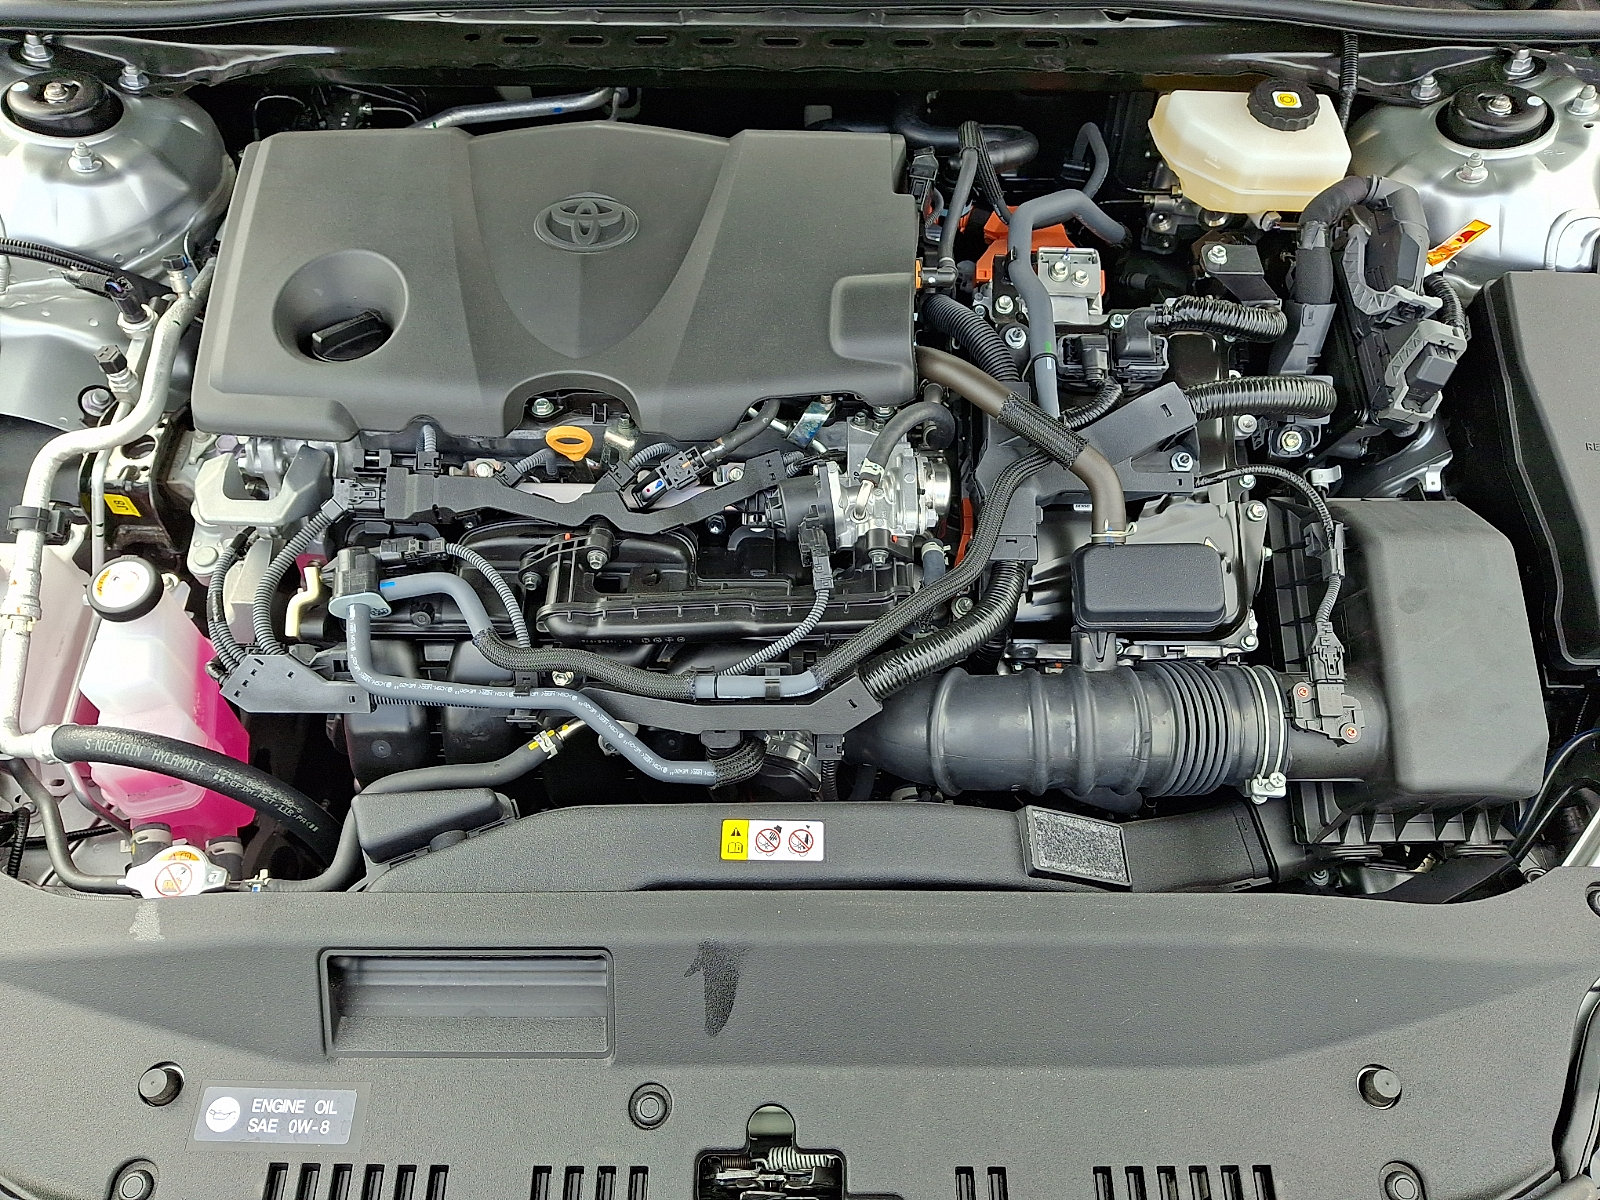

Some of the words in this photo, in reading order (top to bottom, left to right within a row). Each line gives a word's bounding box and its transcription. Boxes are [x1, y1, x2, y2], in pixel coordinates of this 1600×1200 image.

[252, 1098, 307, 1114] ENGINE
[314, 1099, 338, 1115] OIL
[247, 1117, 279, 1133] SAE
[288, 1119, 331, 1135] 0W-8
